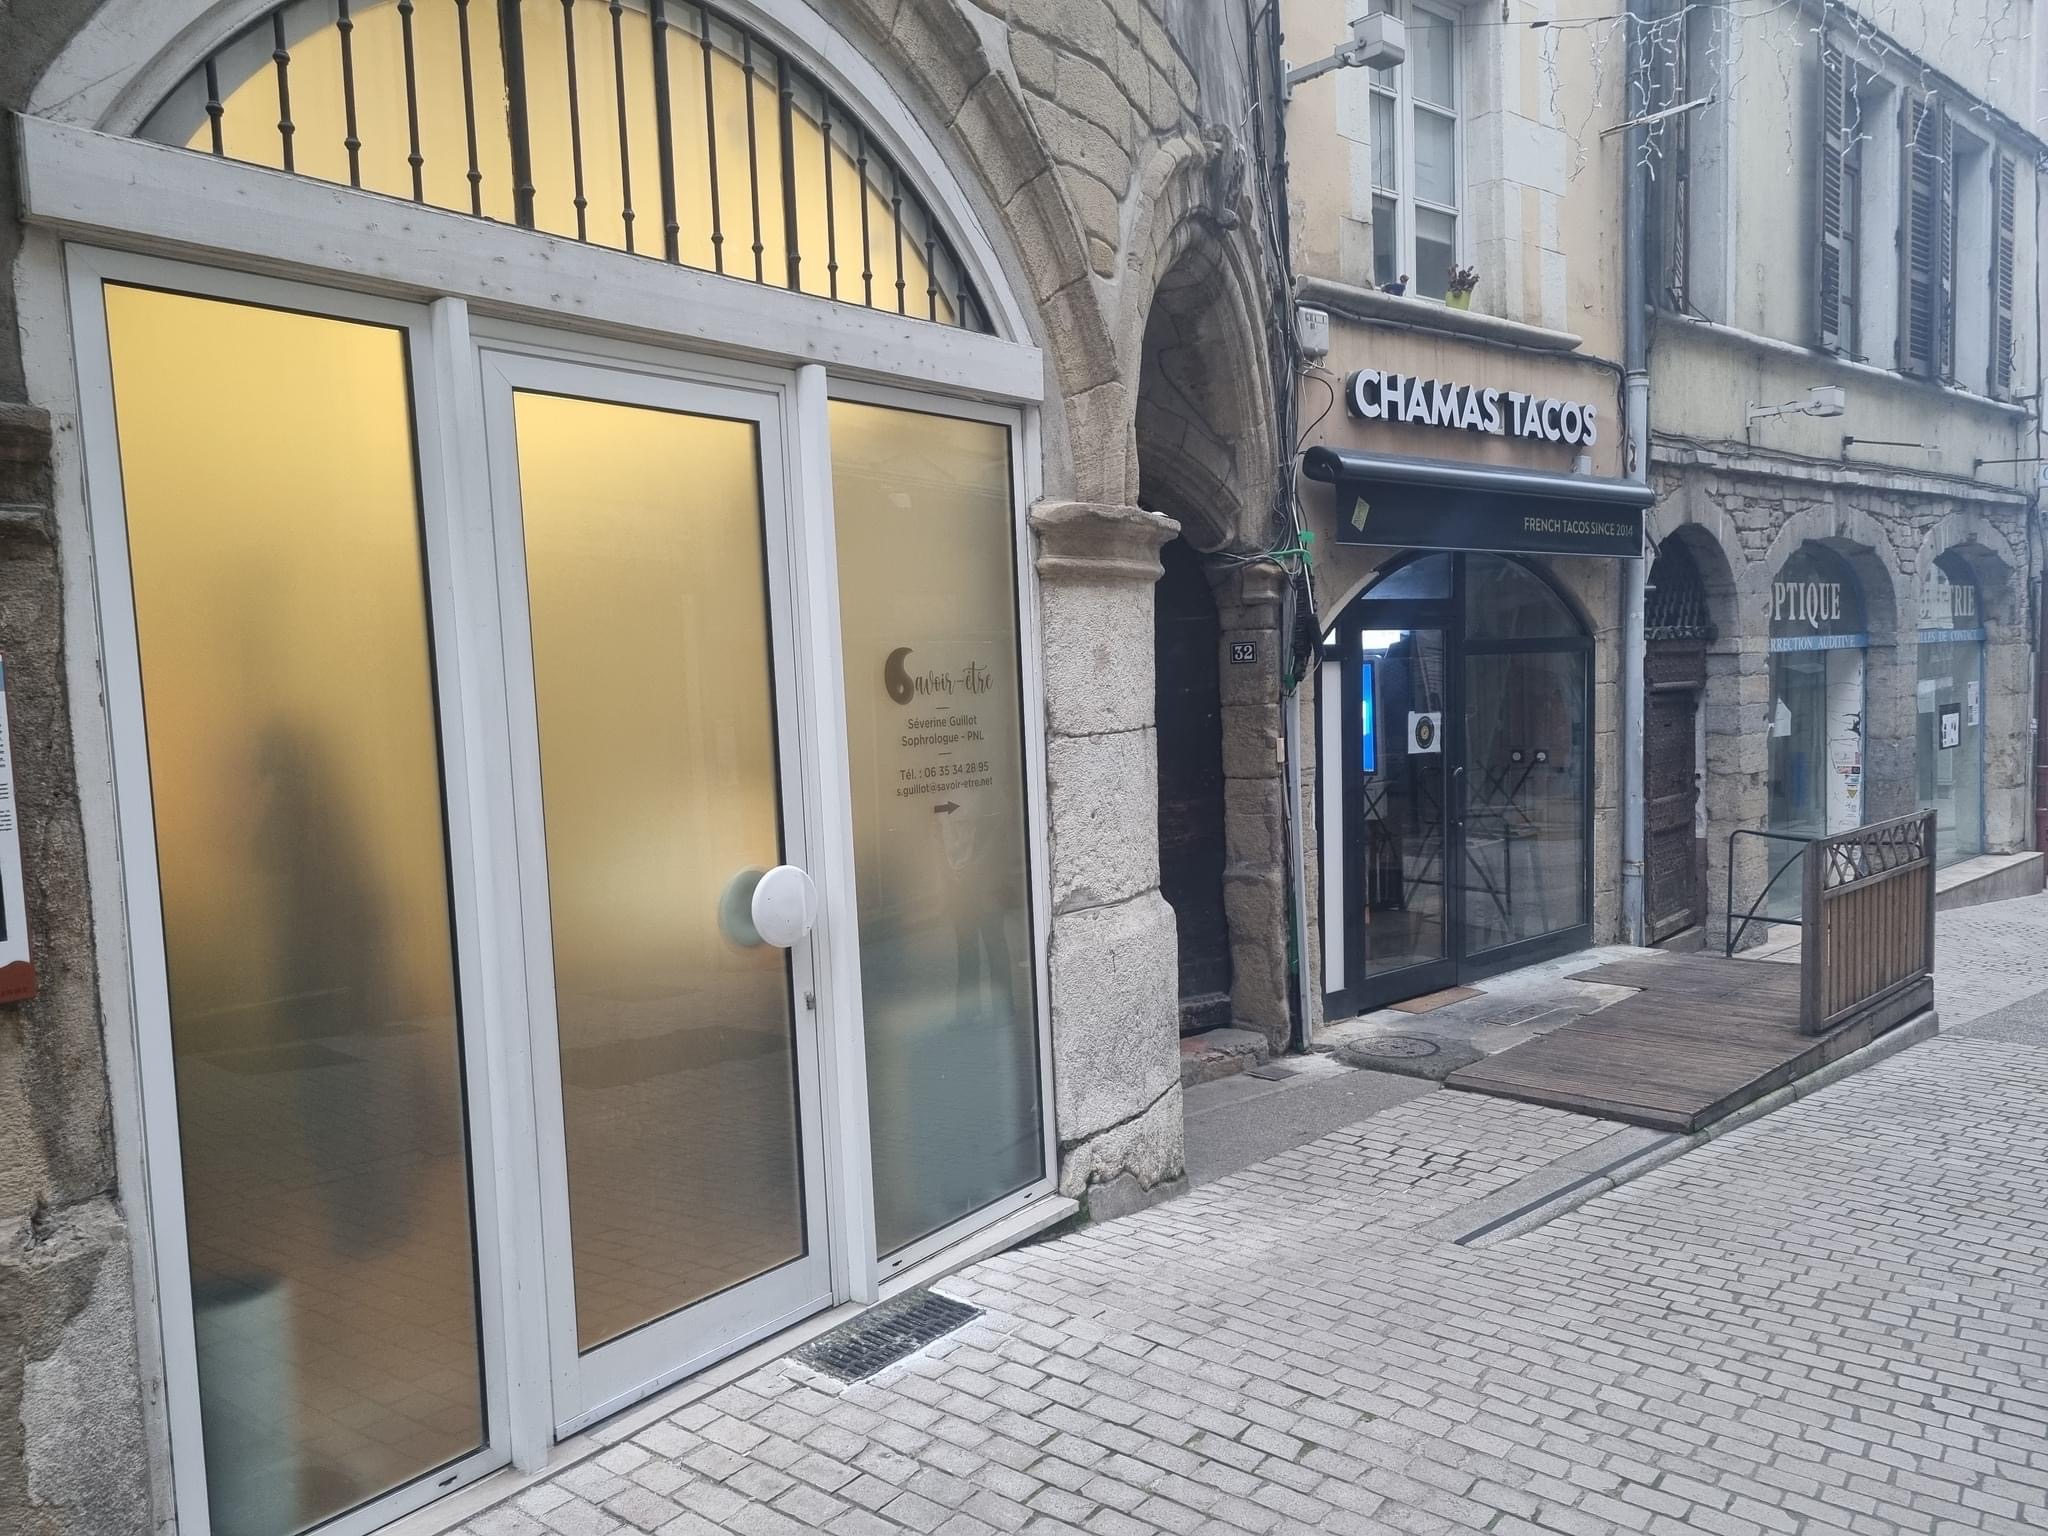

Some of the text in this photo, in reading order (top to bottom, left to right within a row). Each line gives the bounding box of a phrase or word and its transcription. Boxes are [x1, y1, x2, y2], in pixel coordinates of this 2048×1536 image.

[1355, 368, 1598, 446] CHAMAS TACOS
[1523, 517, 1633, 537] FRENCH TACOS SINCE 2014
[1769, 582, 1841, 629] PTIQUE
[1234, 645, 1253, 660] 32
[907, 715, 977, 729] Séverine Guillot
[901, 733, 959, 748] Sophrologue
[967, 731, 984, 741] PNL
[924, 767, 937, 778] 06
[939, 765, 950, 777] 35
[952, 764, 963, 775] 34
[966, 762, 976, 773] 28
[978, 761, 989, 772] 95
